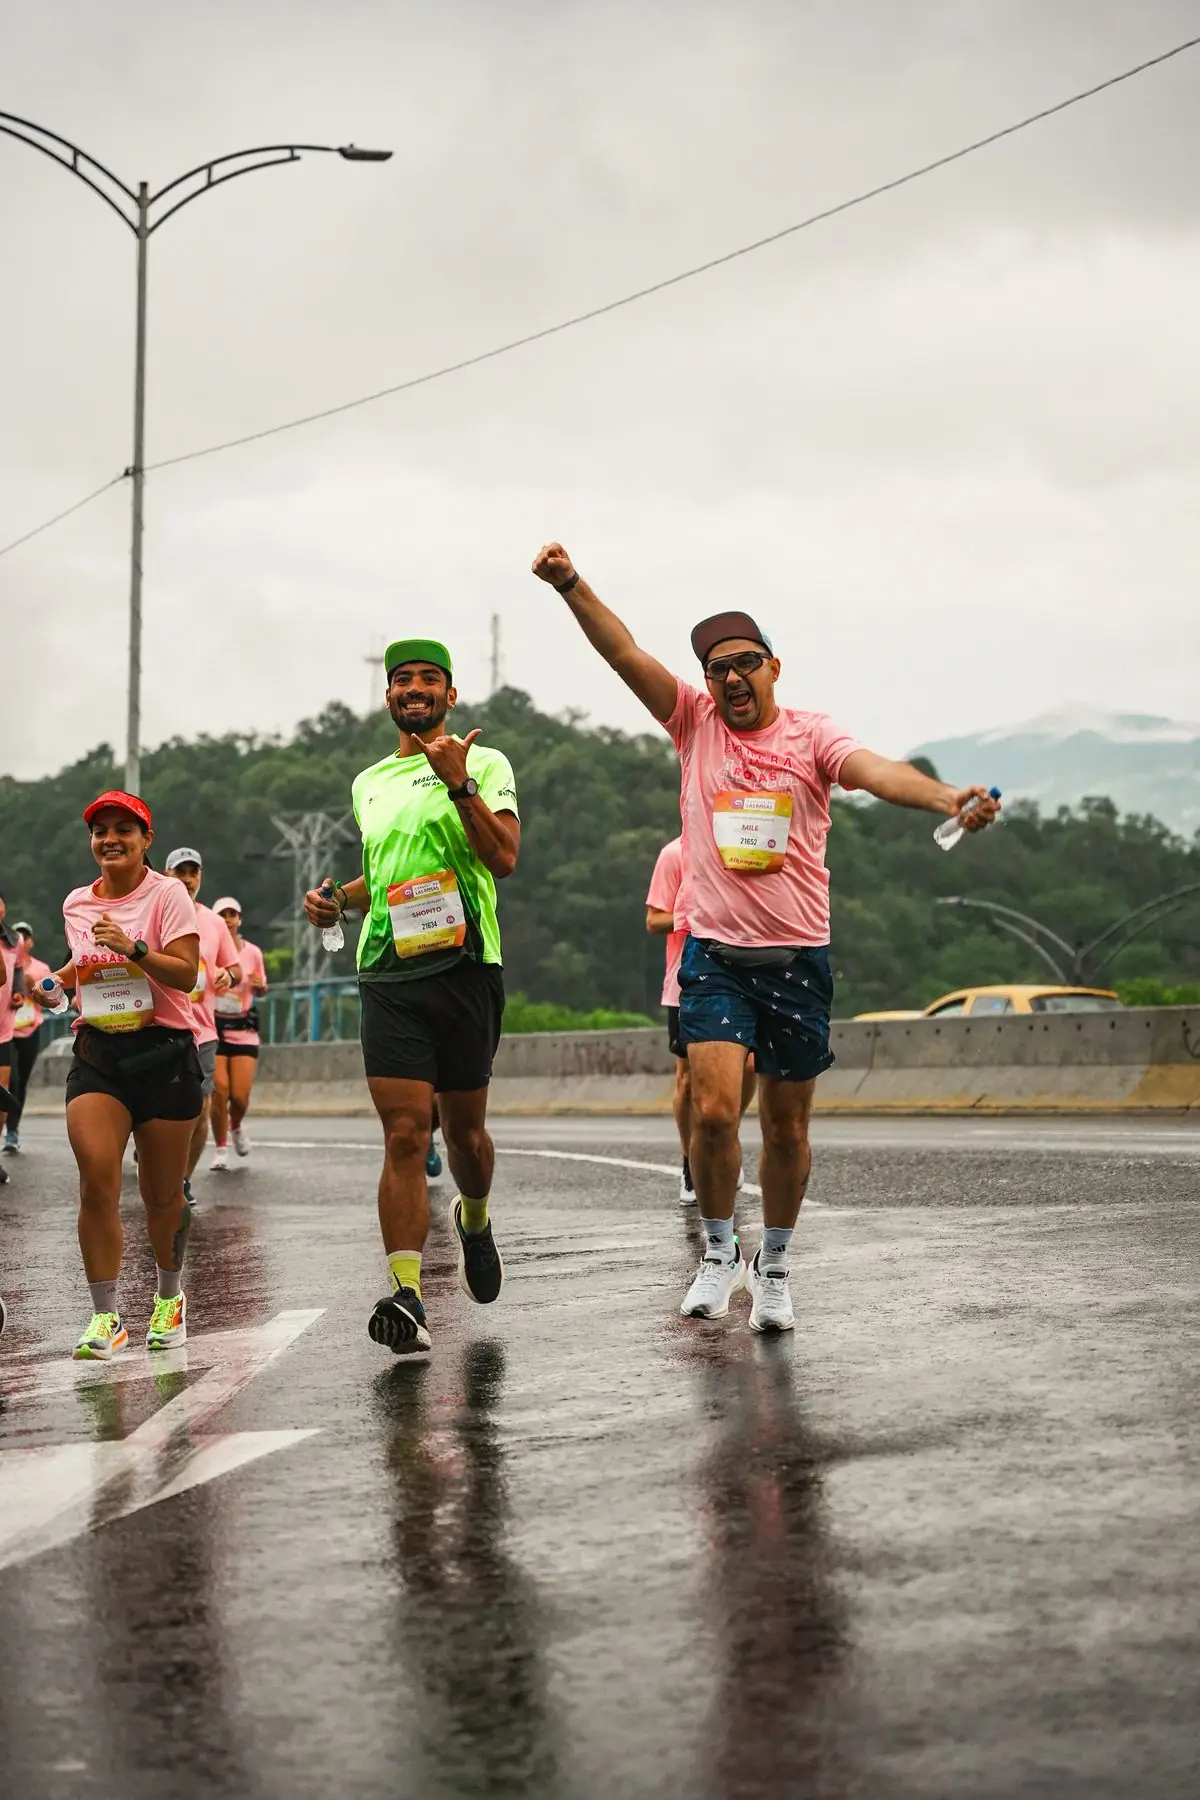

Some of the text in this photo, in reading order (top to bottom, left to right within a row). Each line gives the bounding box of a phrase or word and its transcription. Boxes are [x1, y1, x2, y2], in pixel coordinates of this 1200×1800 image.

[741, 824, 759, 832] MILE
[740, 837, 758, 846] 21652
[411, 906, 442, 918] SHOPITO
[421, 920, 438, 931] 21634
[81, 953, 125, 964] ROSAS
[102, 989, 131, 999] CHECHO
[109, 1003, 126, 1012] 21653
